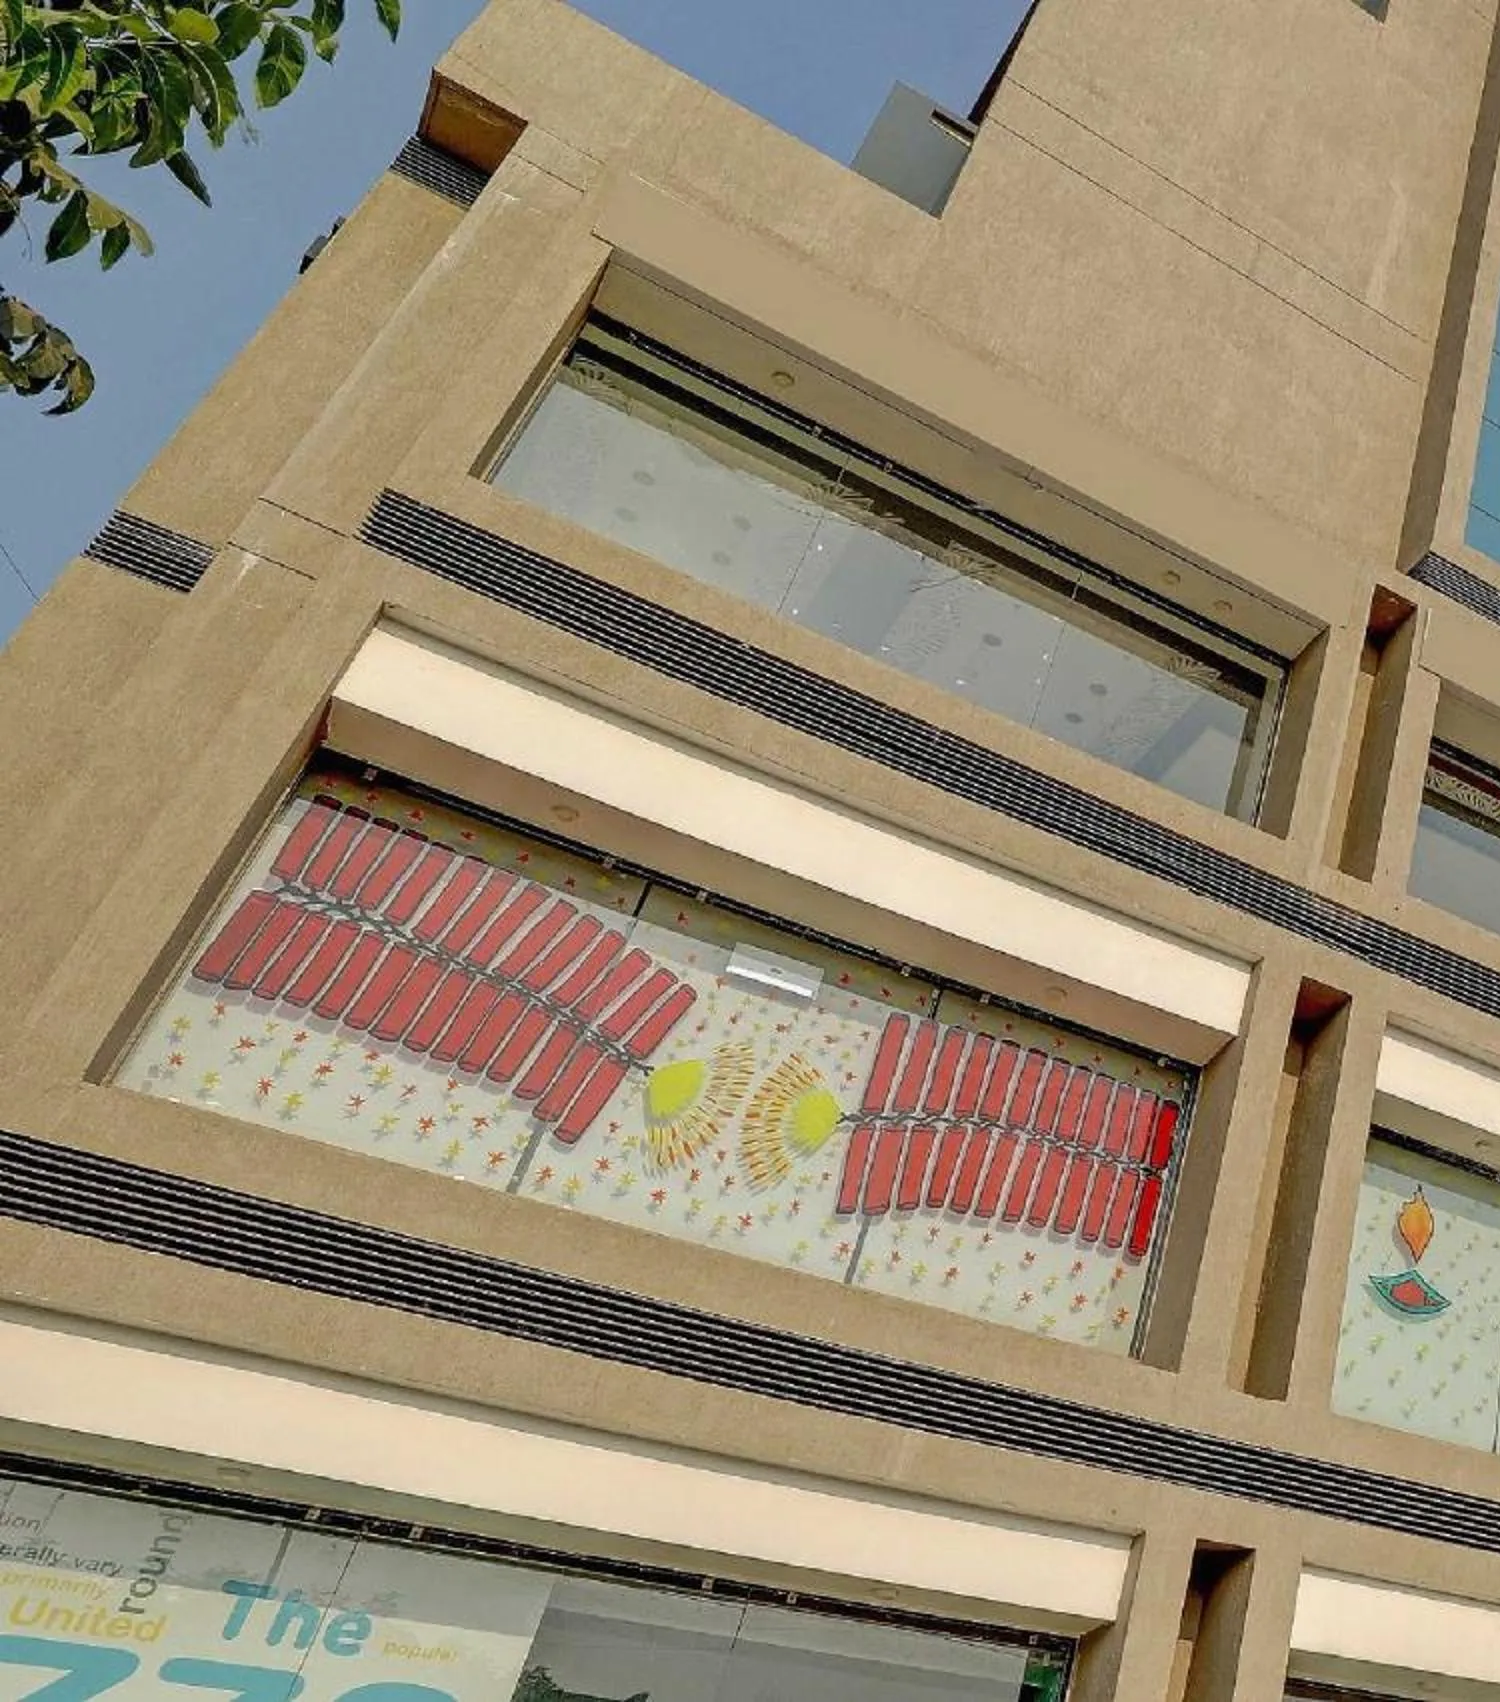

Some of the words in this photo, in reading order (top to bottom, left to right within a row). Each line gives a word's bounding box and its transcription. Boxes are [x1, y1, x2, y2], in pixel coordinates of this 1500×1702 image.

[74, 1556, 124, 1577] vary
[118, 1511, 193, 1614] round
[9, 1596, 168, 1643] United
[222, 1579, 373, 1657] The
